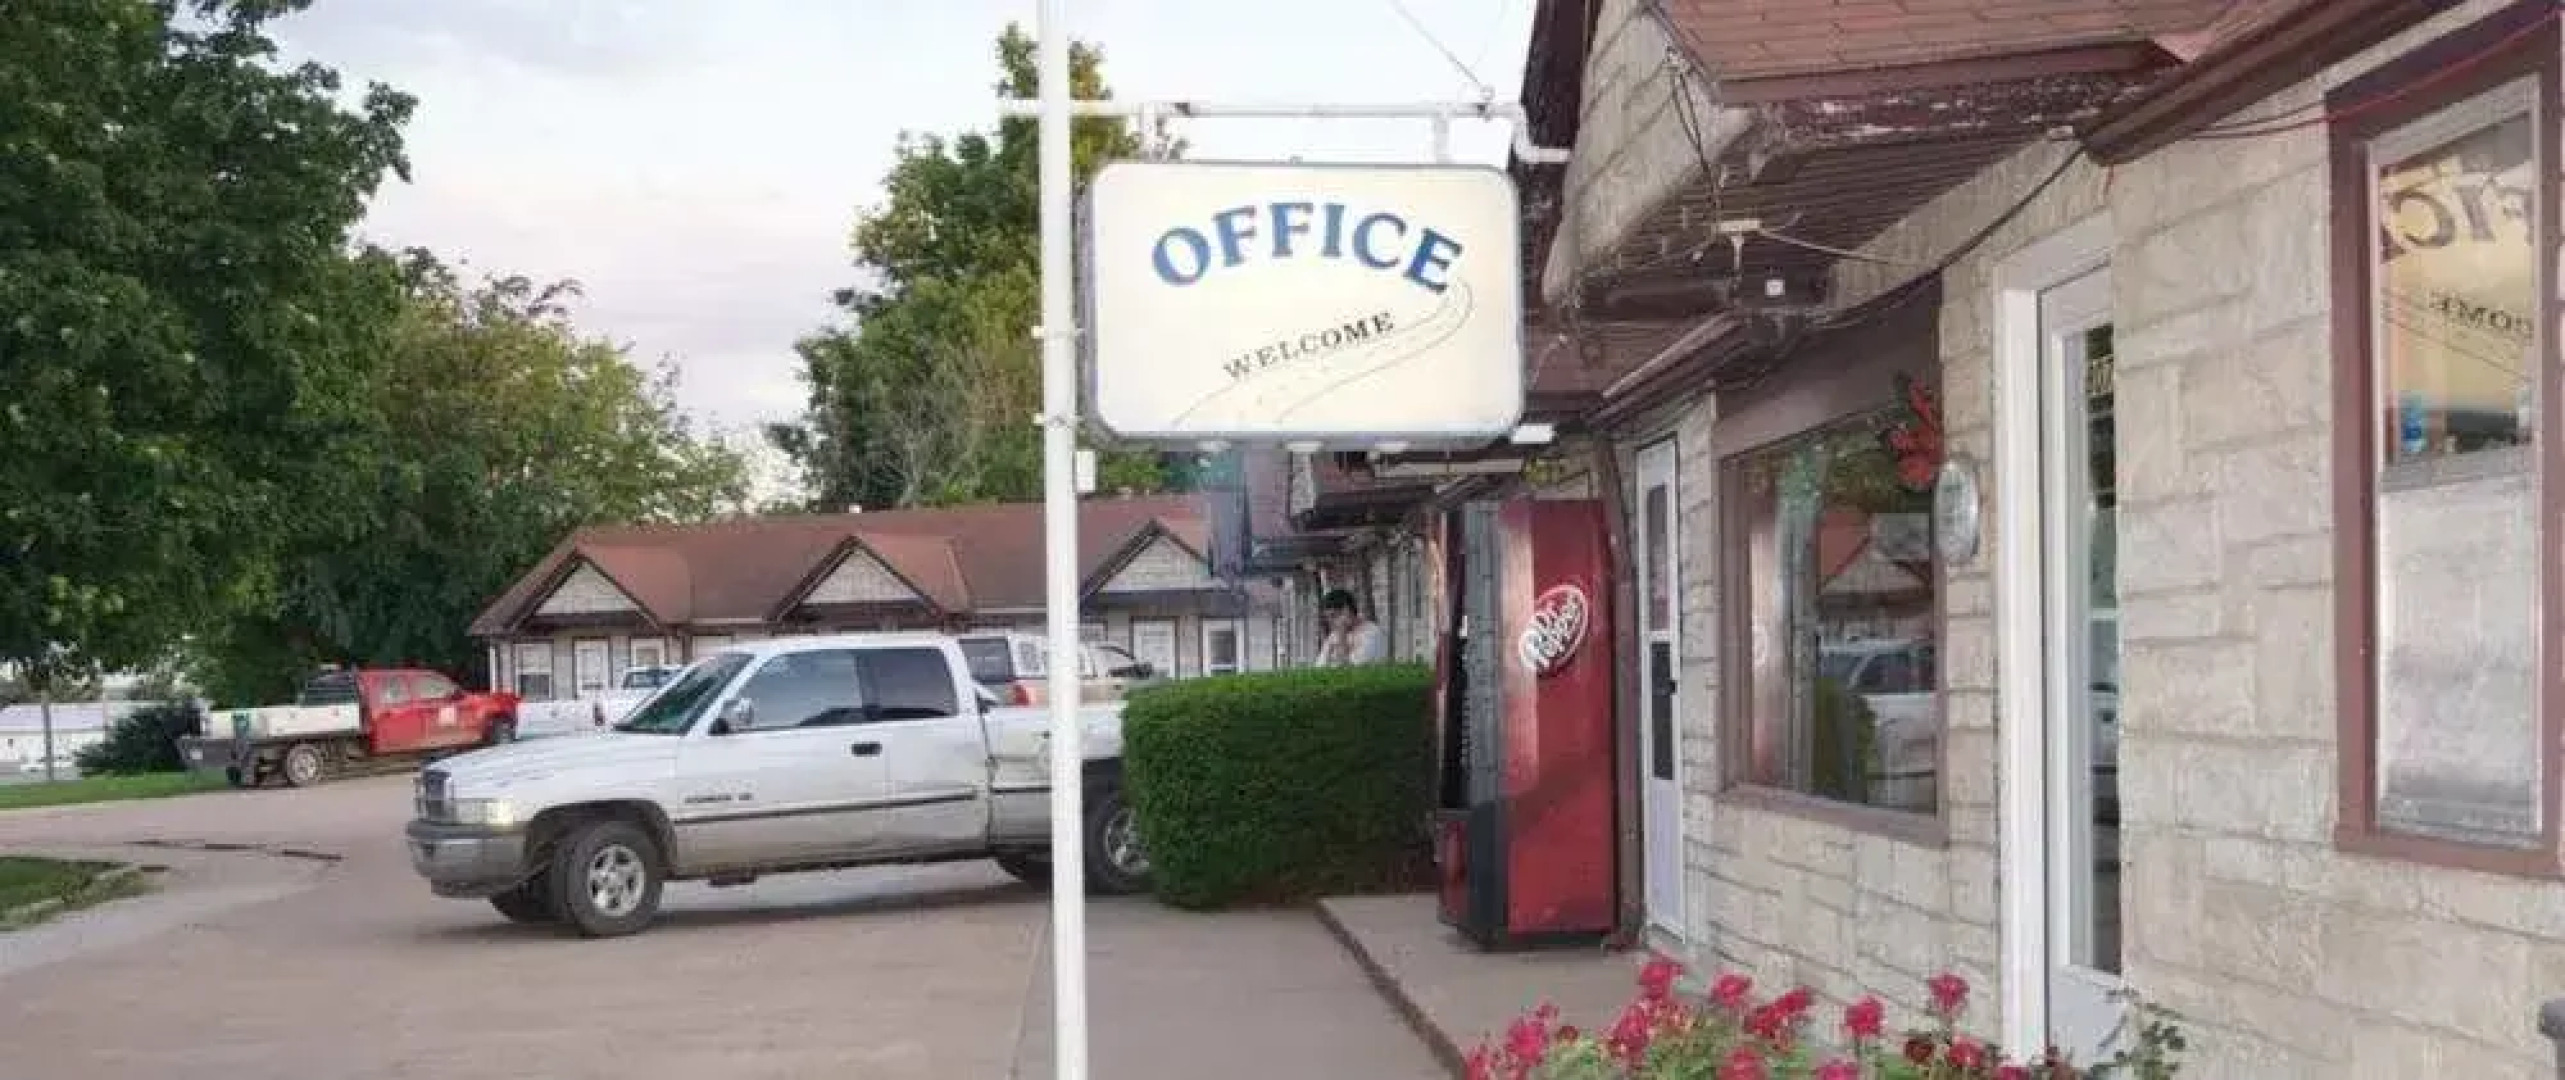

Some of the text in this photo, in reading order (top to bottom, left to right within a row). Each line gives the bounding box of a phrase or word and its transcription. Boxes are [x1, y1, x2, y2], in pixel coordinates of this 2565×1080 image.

[1152, 202, 1463, 293] OFFICE
[1223, 311, 1395, 380] WELCOME
[1519, 592, 1582, 669] Pepper
